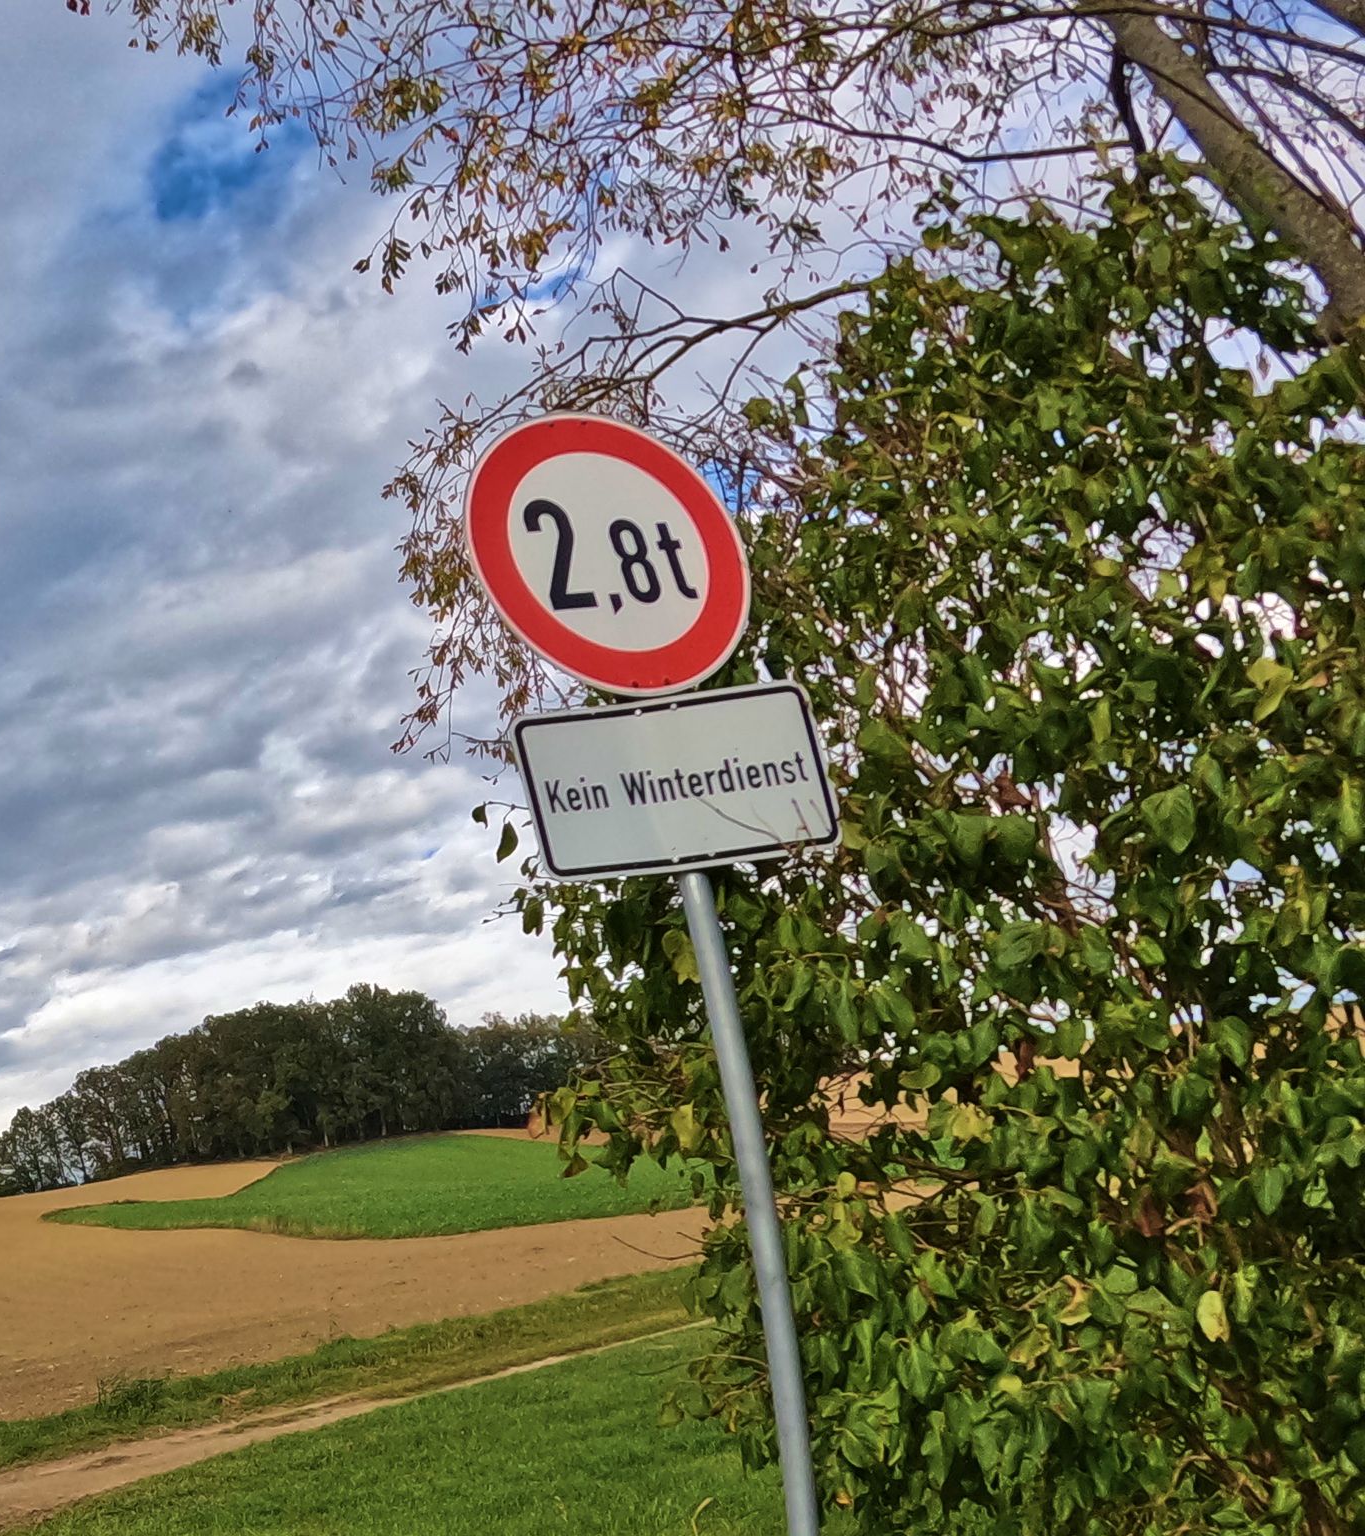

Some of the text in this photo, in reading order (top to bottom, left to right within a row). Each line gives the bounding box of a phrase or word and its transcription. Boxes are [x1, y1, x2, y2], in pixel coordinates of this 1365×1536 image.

[523, 499, 699, 615] 2,8t
[544, 751, 810, 814] Kein Winterdienst
